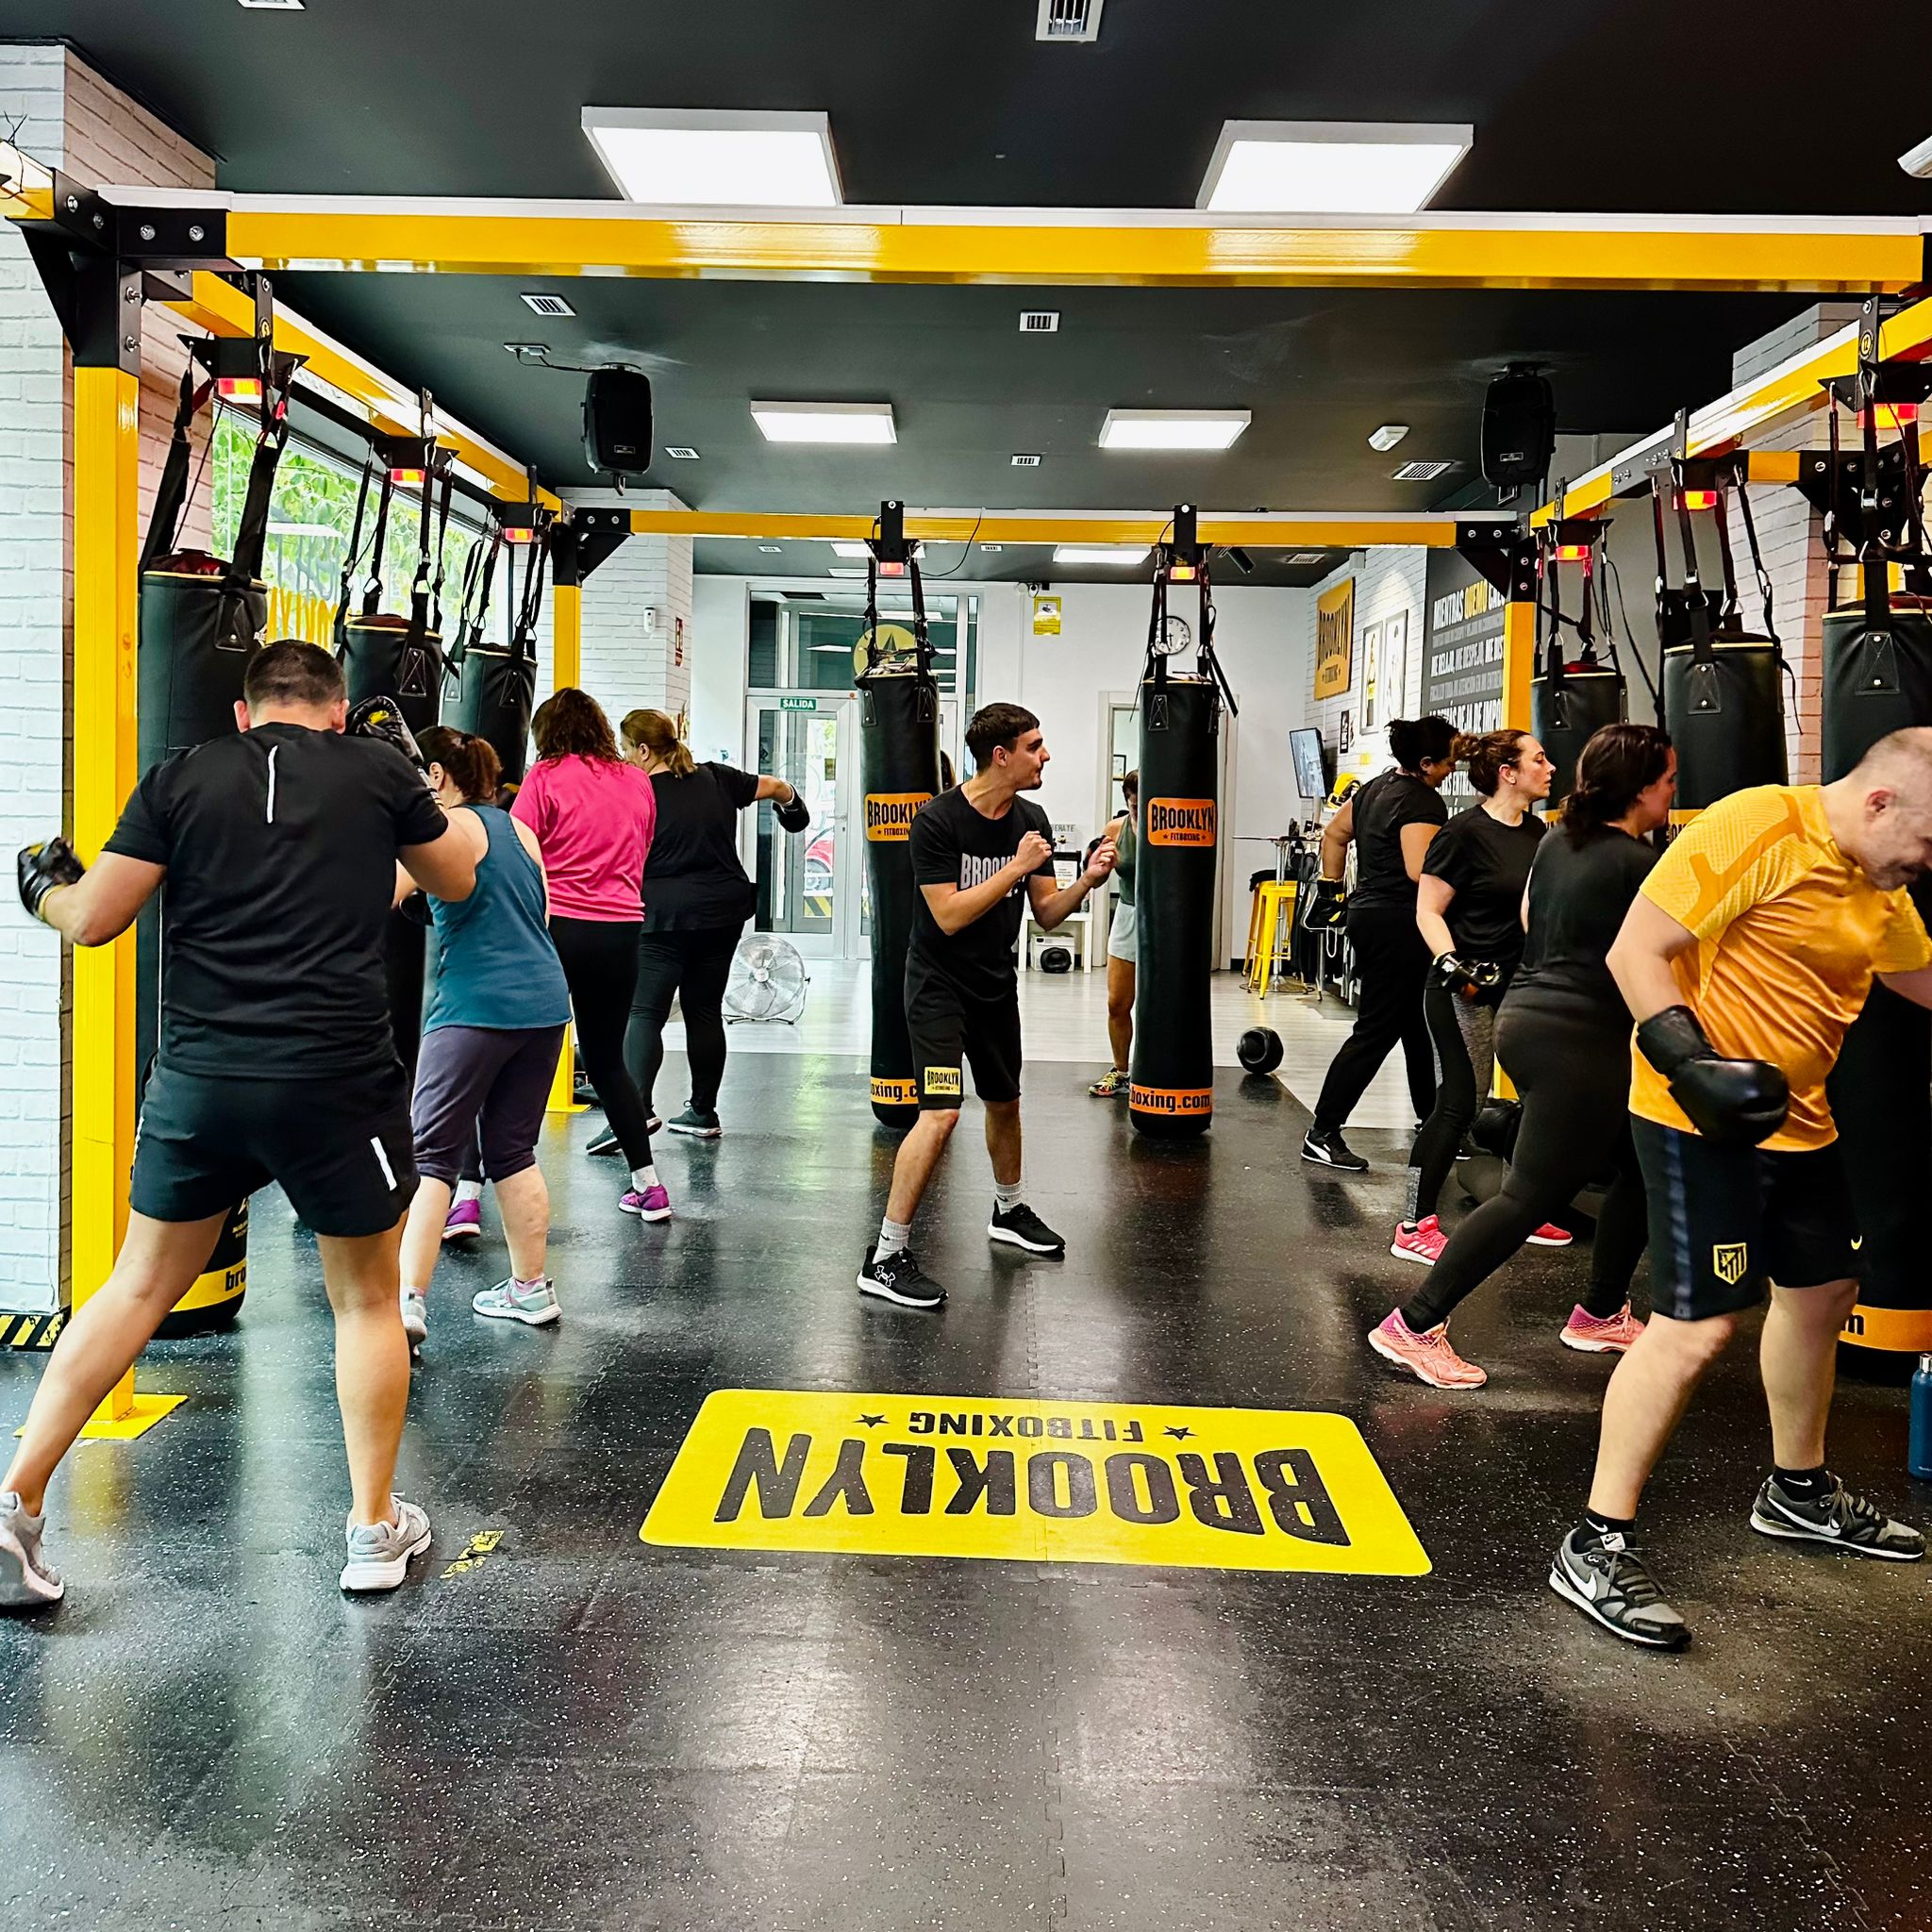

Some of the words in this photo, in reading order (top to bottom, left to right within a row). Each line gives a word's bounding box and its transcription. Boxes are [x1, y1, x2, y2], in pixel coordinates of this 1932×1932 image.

[783, 699, 814, 709] SALIDA
[1482, 698, 1503, 733] IMPO
[868, 798, 931, 828] BROOKL
[1151, 803, 1214, 834] BROOKLYN
[927, 1070, 959, 1086] BROOKLYN
[1131, 1086, 1210, 1113] boxing.com
[908, 1411, 1143, 1442] FITBOXING
[713, 1426, 1351, 1547] BROOKLYN
